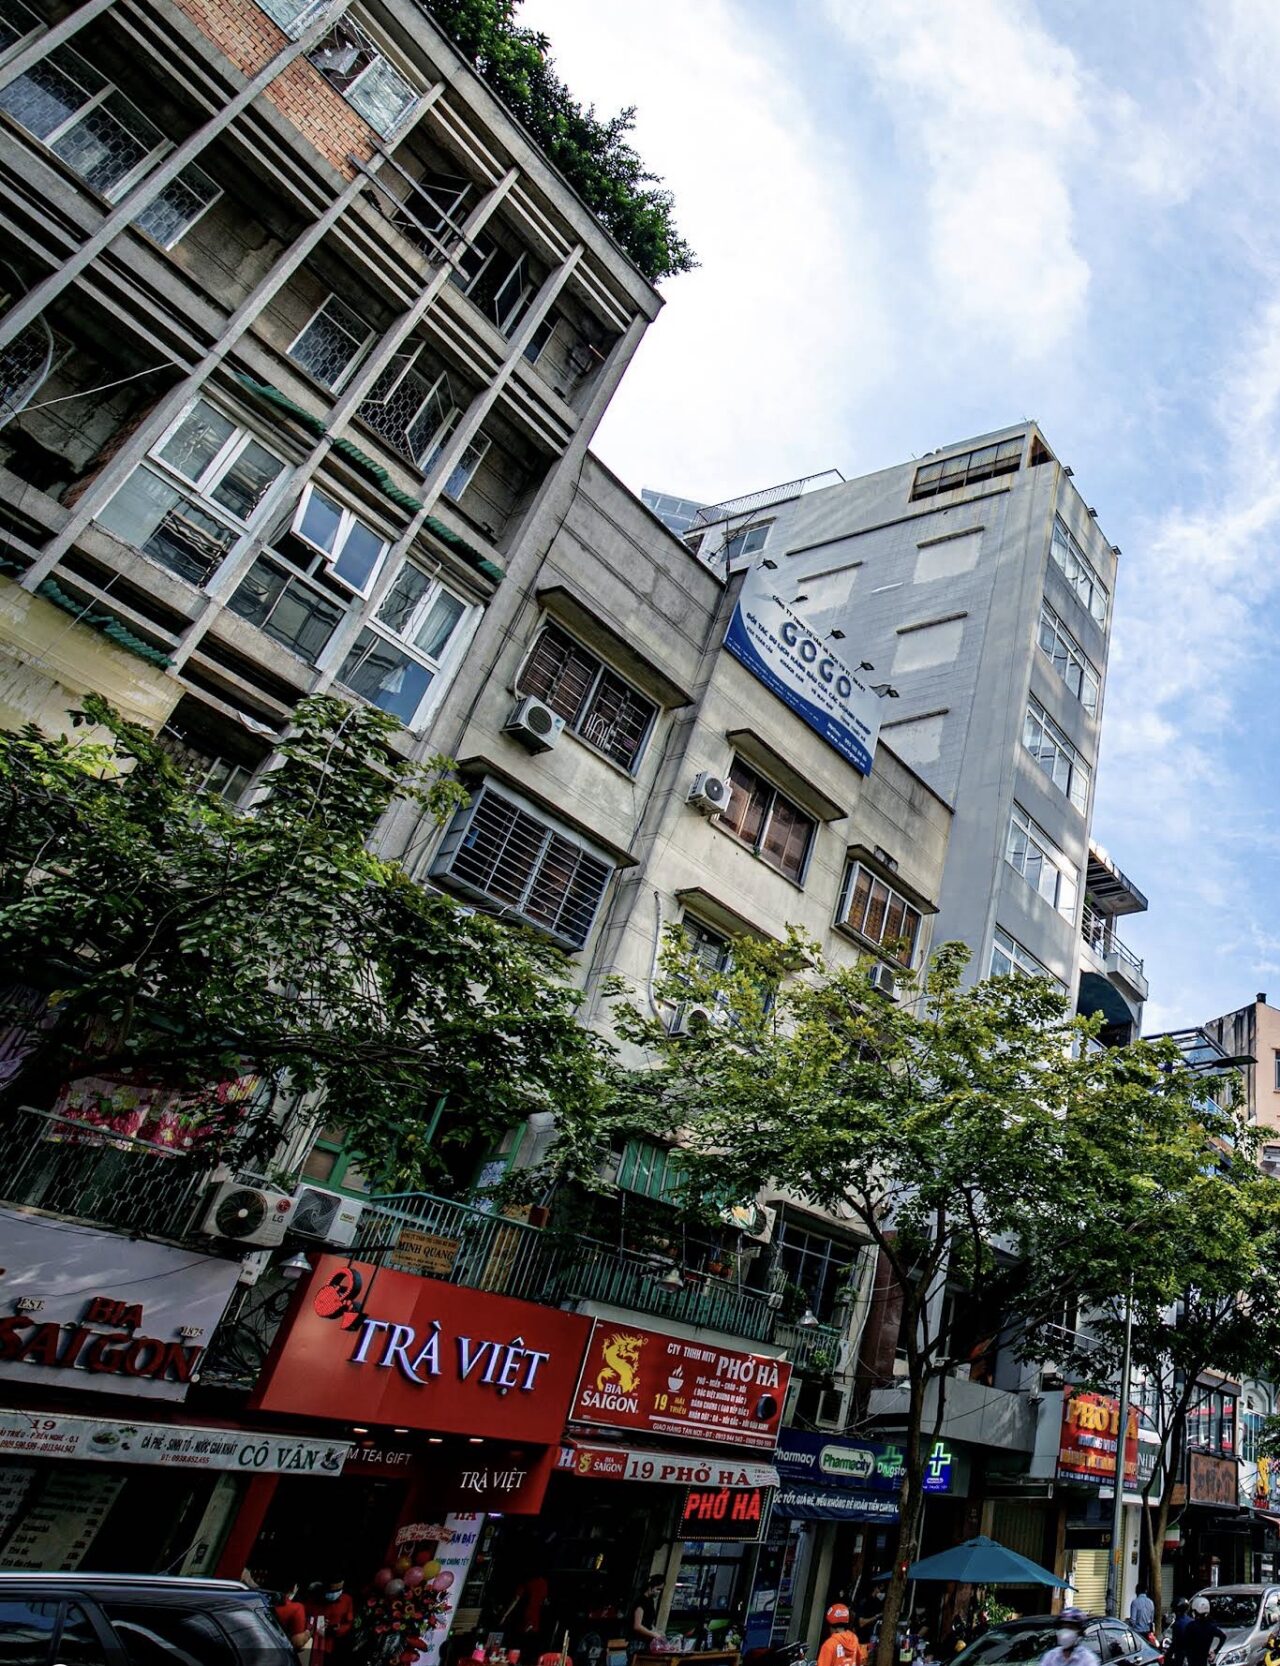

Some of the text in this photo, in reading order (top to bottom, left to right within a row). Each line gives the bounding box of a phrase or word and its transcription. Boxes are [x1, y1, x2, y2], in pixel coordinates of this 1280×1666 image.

[781, 621, 852, 698] GOGO
[272, 1214, 285, 1223] LG
[423, 1246, 454, 1261] QUANG
[86, 1296, 143, 1328] BIA
[0, 1315, 204, 1384] SAIGON
[350, 1320, 550, 1395] TRÀ VIỆT
[667, 1343, 681, 1355] CTY
[701, 1350, 716, 1363] MTV
[716, 1355, 779, 1389] PHỞ HÀ
[604, 1382, 622, 1395] BIA
[580, 1390, 639, 1413] SAIGON
[653, 1393, 669, 1411] 19
[30, 1419, 56, 1430] 19
[653, 1423, 667, 1431] GIAO
[238, 1441, 320, 1470] CÔ VÂN
[362, 1448, 383, 1462] TEA
[385, 1451, 413, 1466] GIFT
[593, 1461, 623, 1473] SAIGON
[774, 1447, 816, 1468] Pharmacy
[824, 1453, 871, 1475] Pharmacity
[877, 1462, 907, 1478] Drugsto
[460, 1467, 527, 1493] TRÀ VIỆT
[630, 1461, 654, 1479] 19
[660, 1462, 713, 1483] PHỞ
[718, 1468, 752, 1486] HÀ
[684, 1486, 761, 1520] PHỞ HÀ
[461, 1532, 476, 1546] ĐẶT
